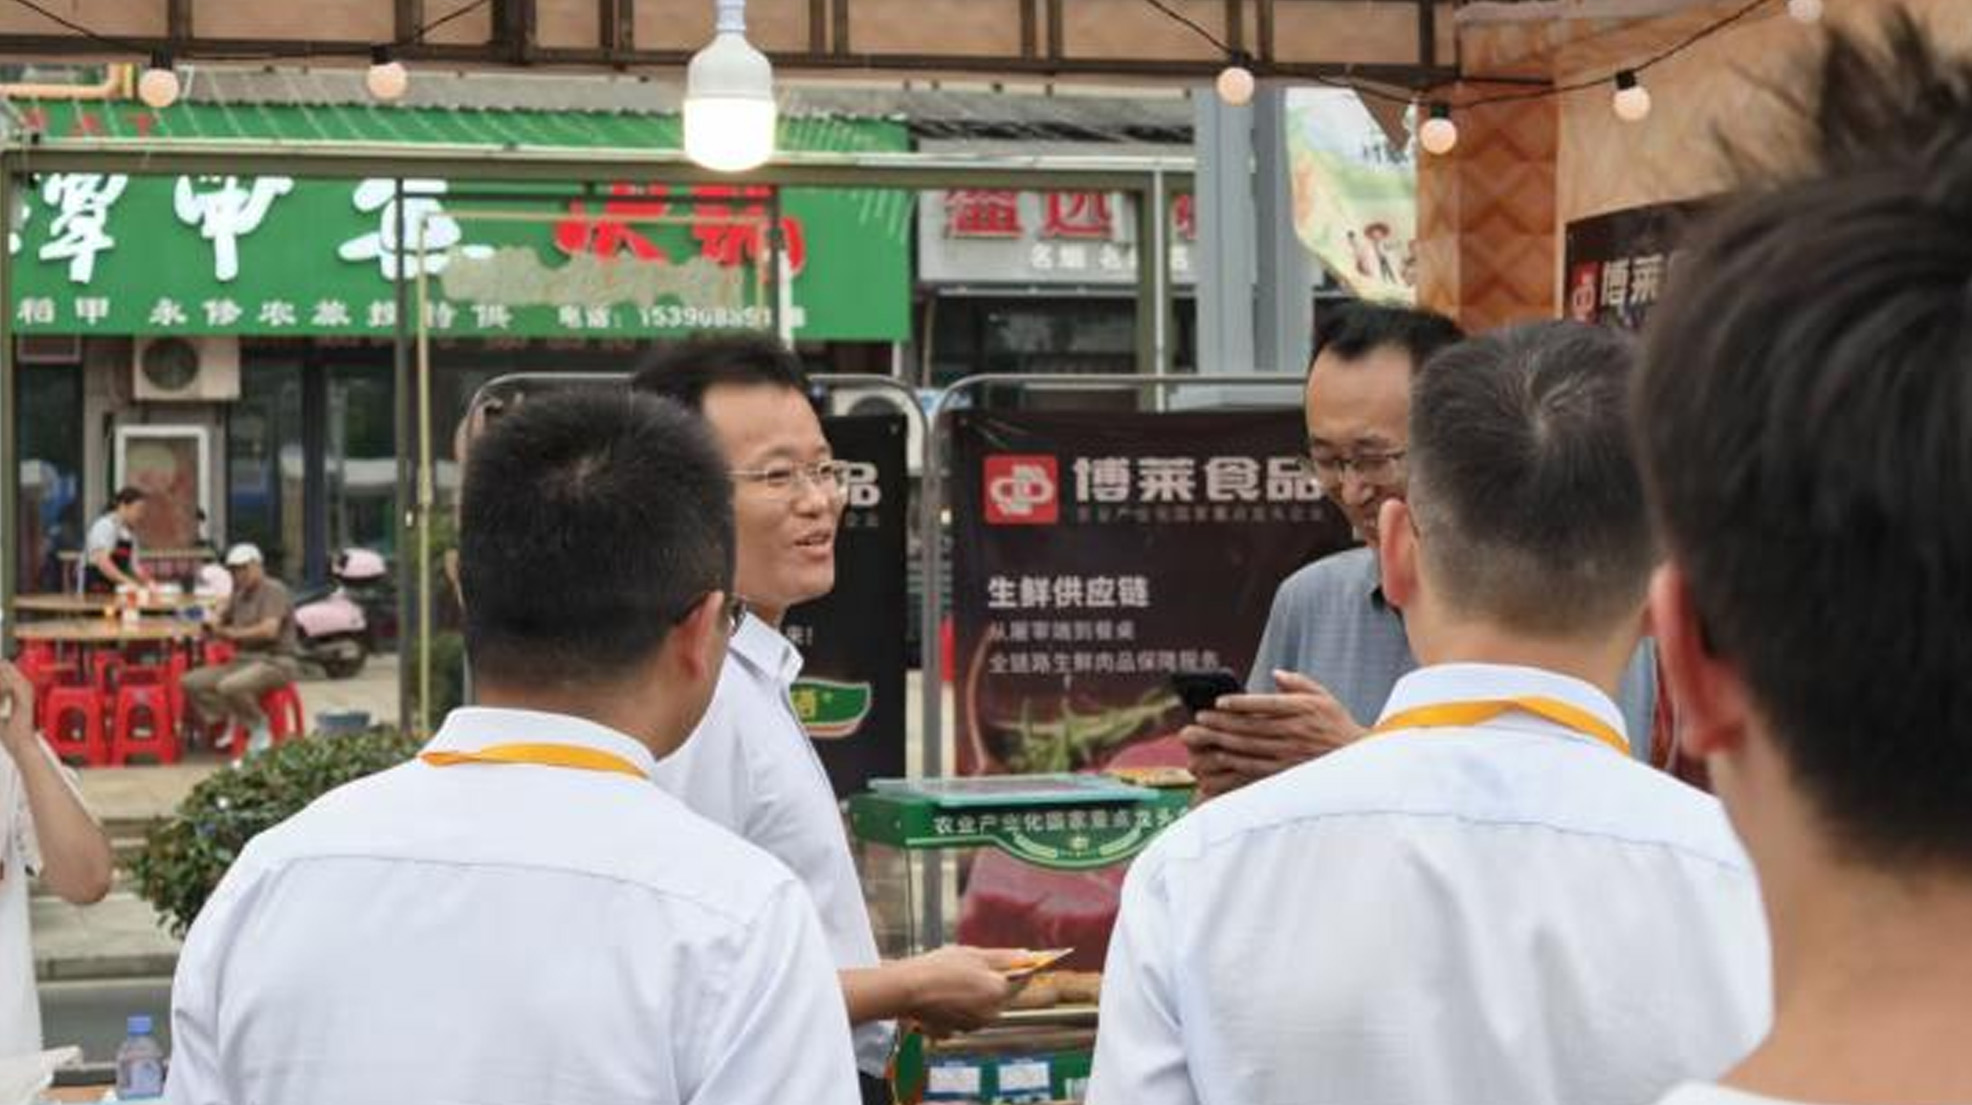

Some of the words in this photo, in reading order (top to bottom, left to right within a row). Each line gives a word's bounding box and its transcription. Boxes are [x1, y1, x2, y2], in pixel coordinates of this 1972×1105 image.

[1072, 456, 1323, 502] 博莱食品
[987, 575, 1150, 608] 生鲜供应链
